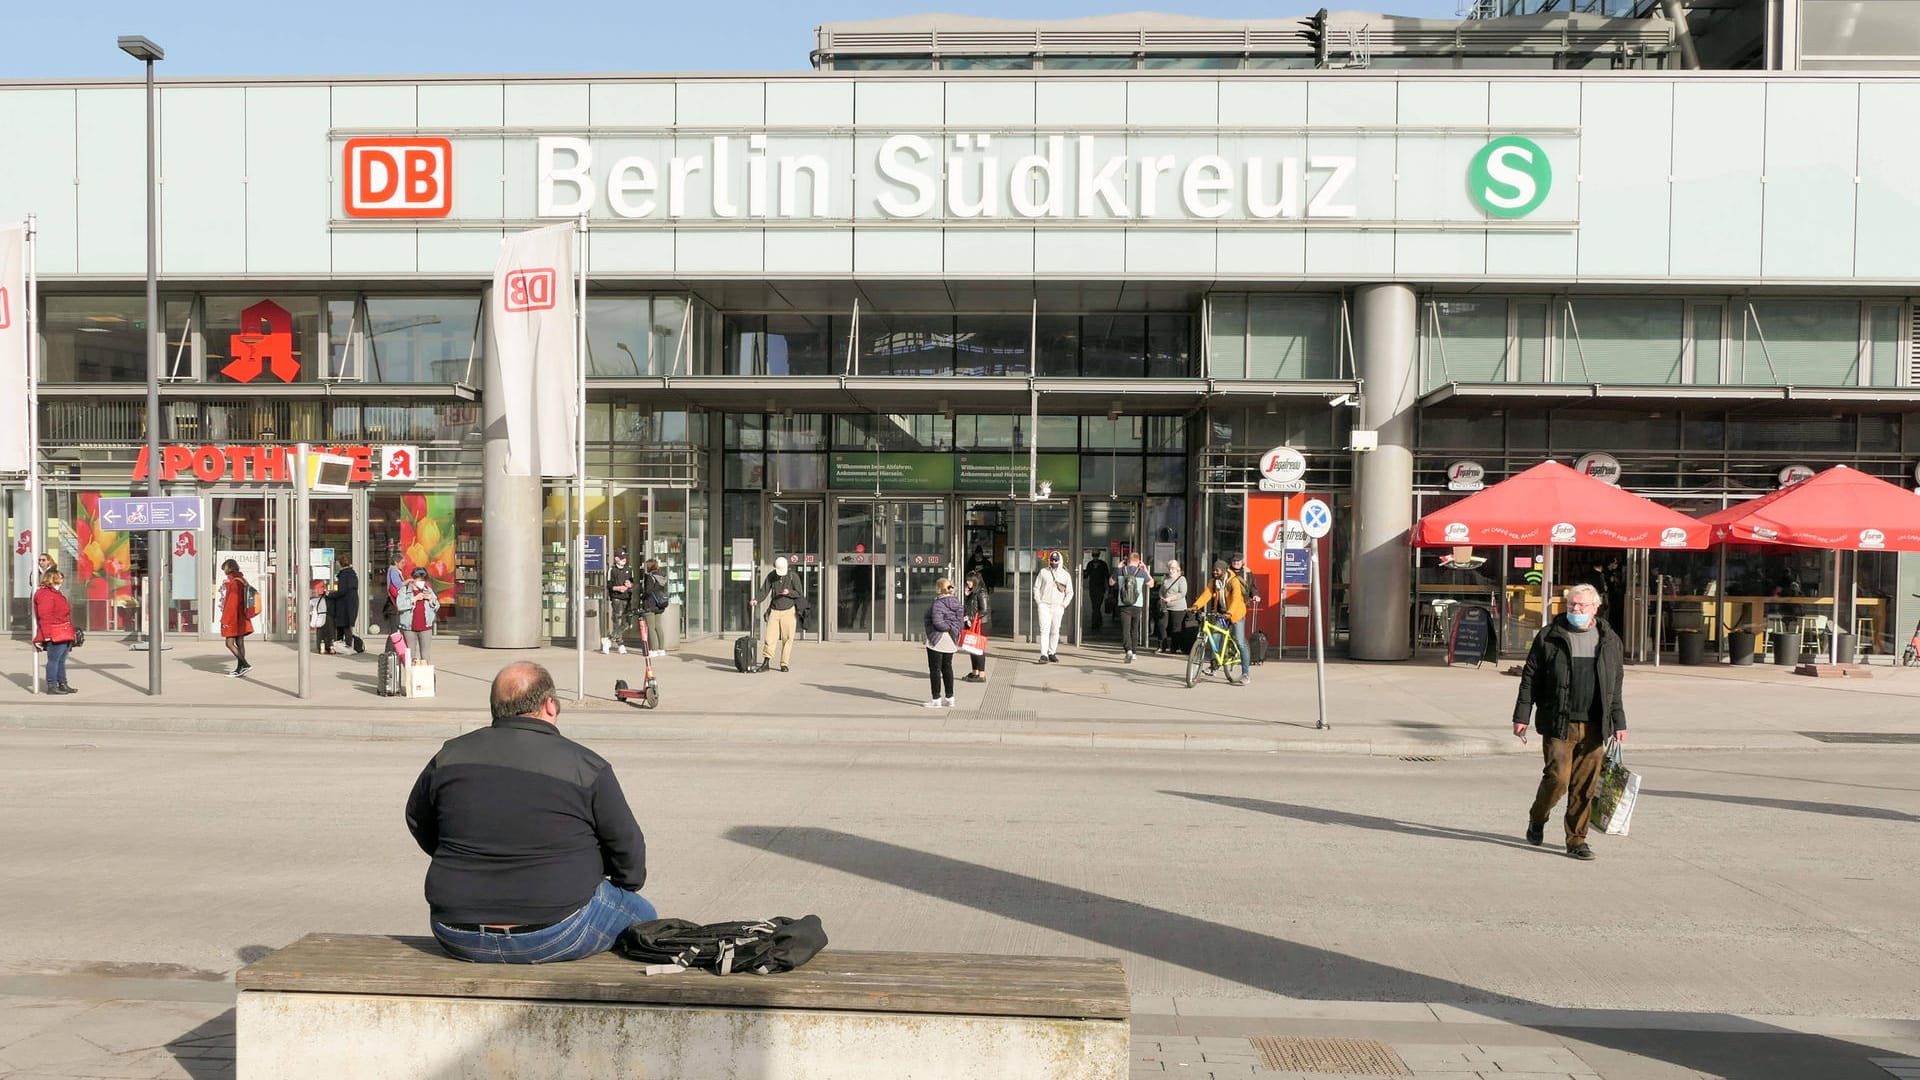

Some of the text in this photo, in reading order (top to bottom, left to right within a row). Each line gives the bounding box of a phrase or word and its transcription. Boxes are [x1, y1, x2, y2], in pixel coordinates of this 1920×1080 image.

[360, 149, 439, 204] DB
[536, 134, 1357, 218] Berlin Südkreuz
[1483, 145, 1537, 209] S
[132, 444, 373, 482] APOTHE
